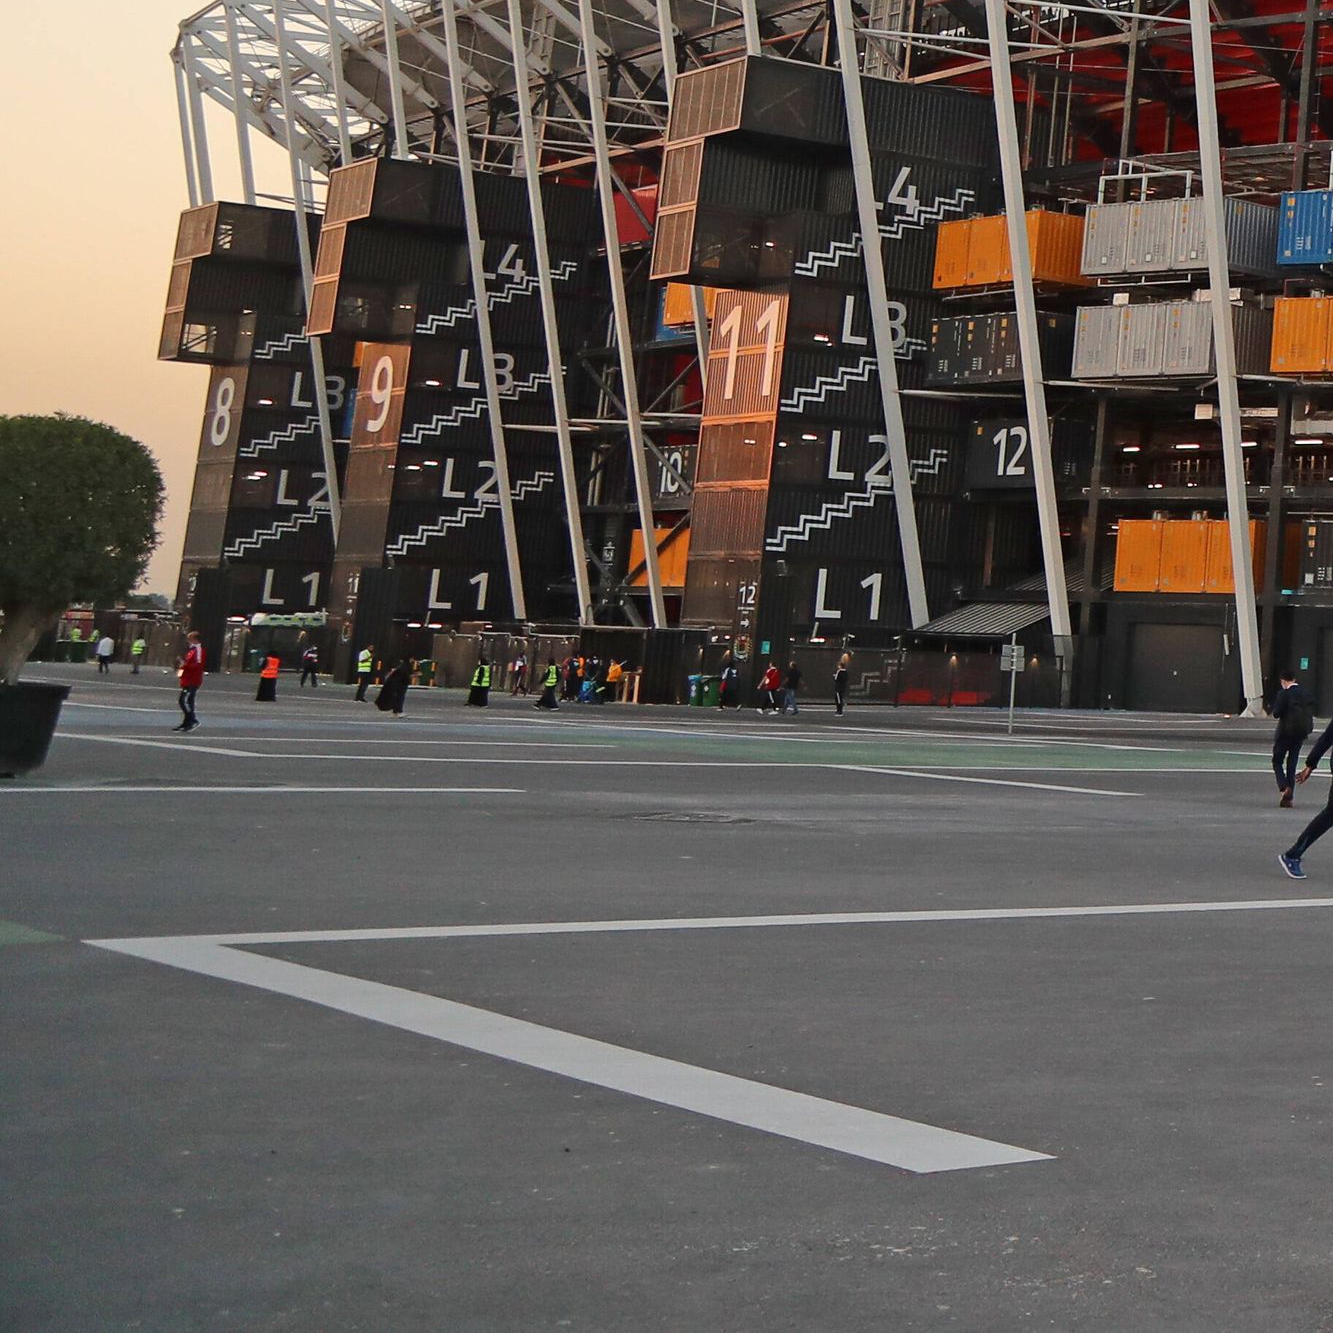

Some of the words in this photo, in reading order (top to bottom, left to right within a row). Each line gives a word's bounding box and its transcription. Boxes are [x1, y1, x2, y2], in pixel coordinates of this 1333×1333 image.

[842, 295, 907, 349] L3
[457, 349, 515, 393] L3
[720, 300, 780, 400] 11
[211, 377, 235, 446] 8
[291, 372, 346, 411] L3
[366, 356, 393, 433] 9
[828, 430, 892, 482] L2
[993, 426, 1028, 476] 12
[277, 469, 330, 506] L2
[442, 458, 499, 499] L2
[739, 585, 757, 604] 12
